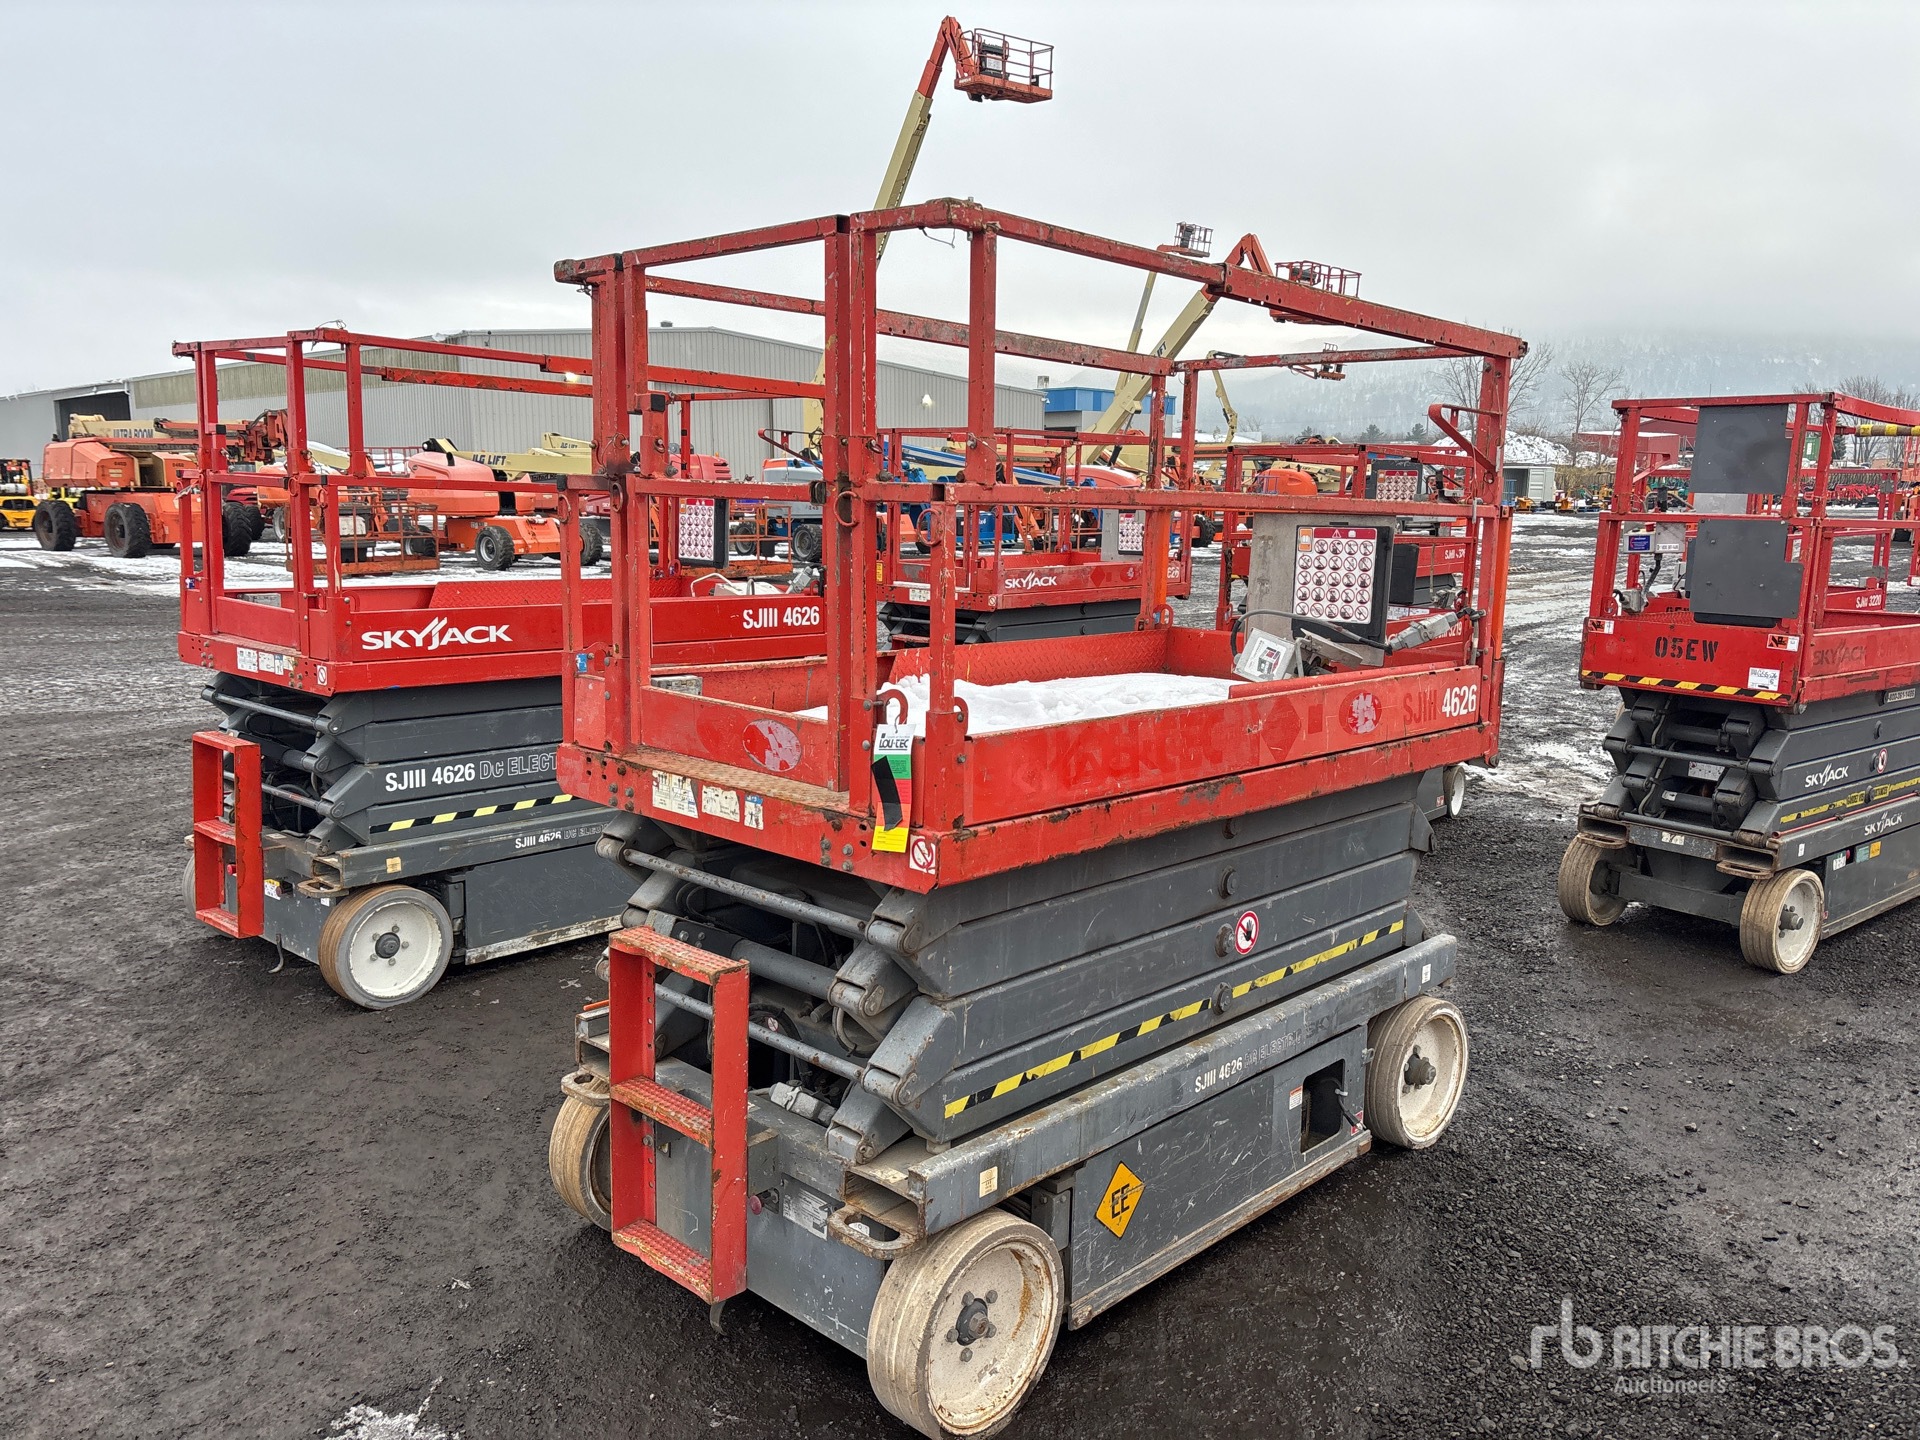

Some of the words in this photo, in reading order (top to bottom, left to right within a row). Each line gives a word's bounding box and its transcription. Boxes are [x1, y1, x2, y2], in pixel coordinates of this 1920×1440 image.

[113, 429, 132, 438] ULTRA
[134, 429, 153, 438] BOOM
[471, 454, 486, 465] JLG
[487, 455, 507, 466] LIFT
[1004, 571, 1058, 590] SKYJACK
[742, 608, 778, 630] SJIII
[783, 606, 820, 627] 4626
[361, 616, 513, 651] SKYJACK
[1441, 684, 1478, 718] 4626
[385, 769, 426, 792] SJIII
[431, 763, 476, 785] 4626
[479, 760, 504, 780] DC
[1804, 761, 1849, 788] SKYJACK
[1864, 812, 1903, 837] SKYJACK
[515, 835, 536, 849] SJIII
[1194, 1068, 1217, 1093] SJIII
[1219, 1056, 1243, 1080] 4626
[1111, 1183, 1130, 1219] EE
